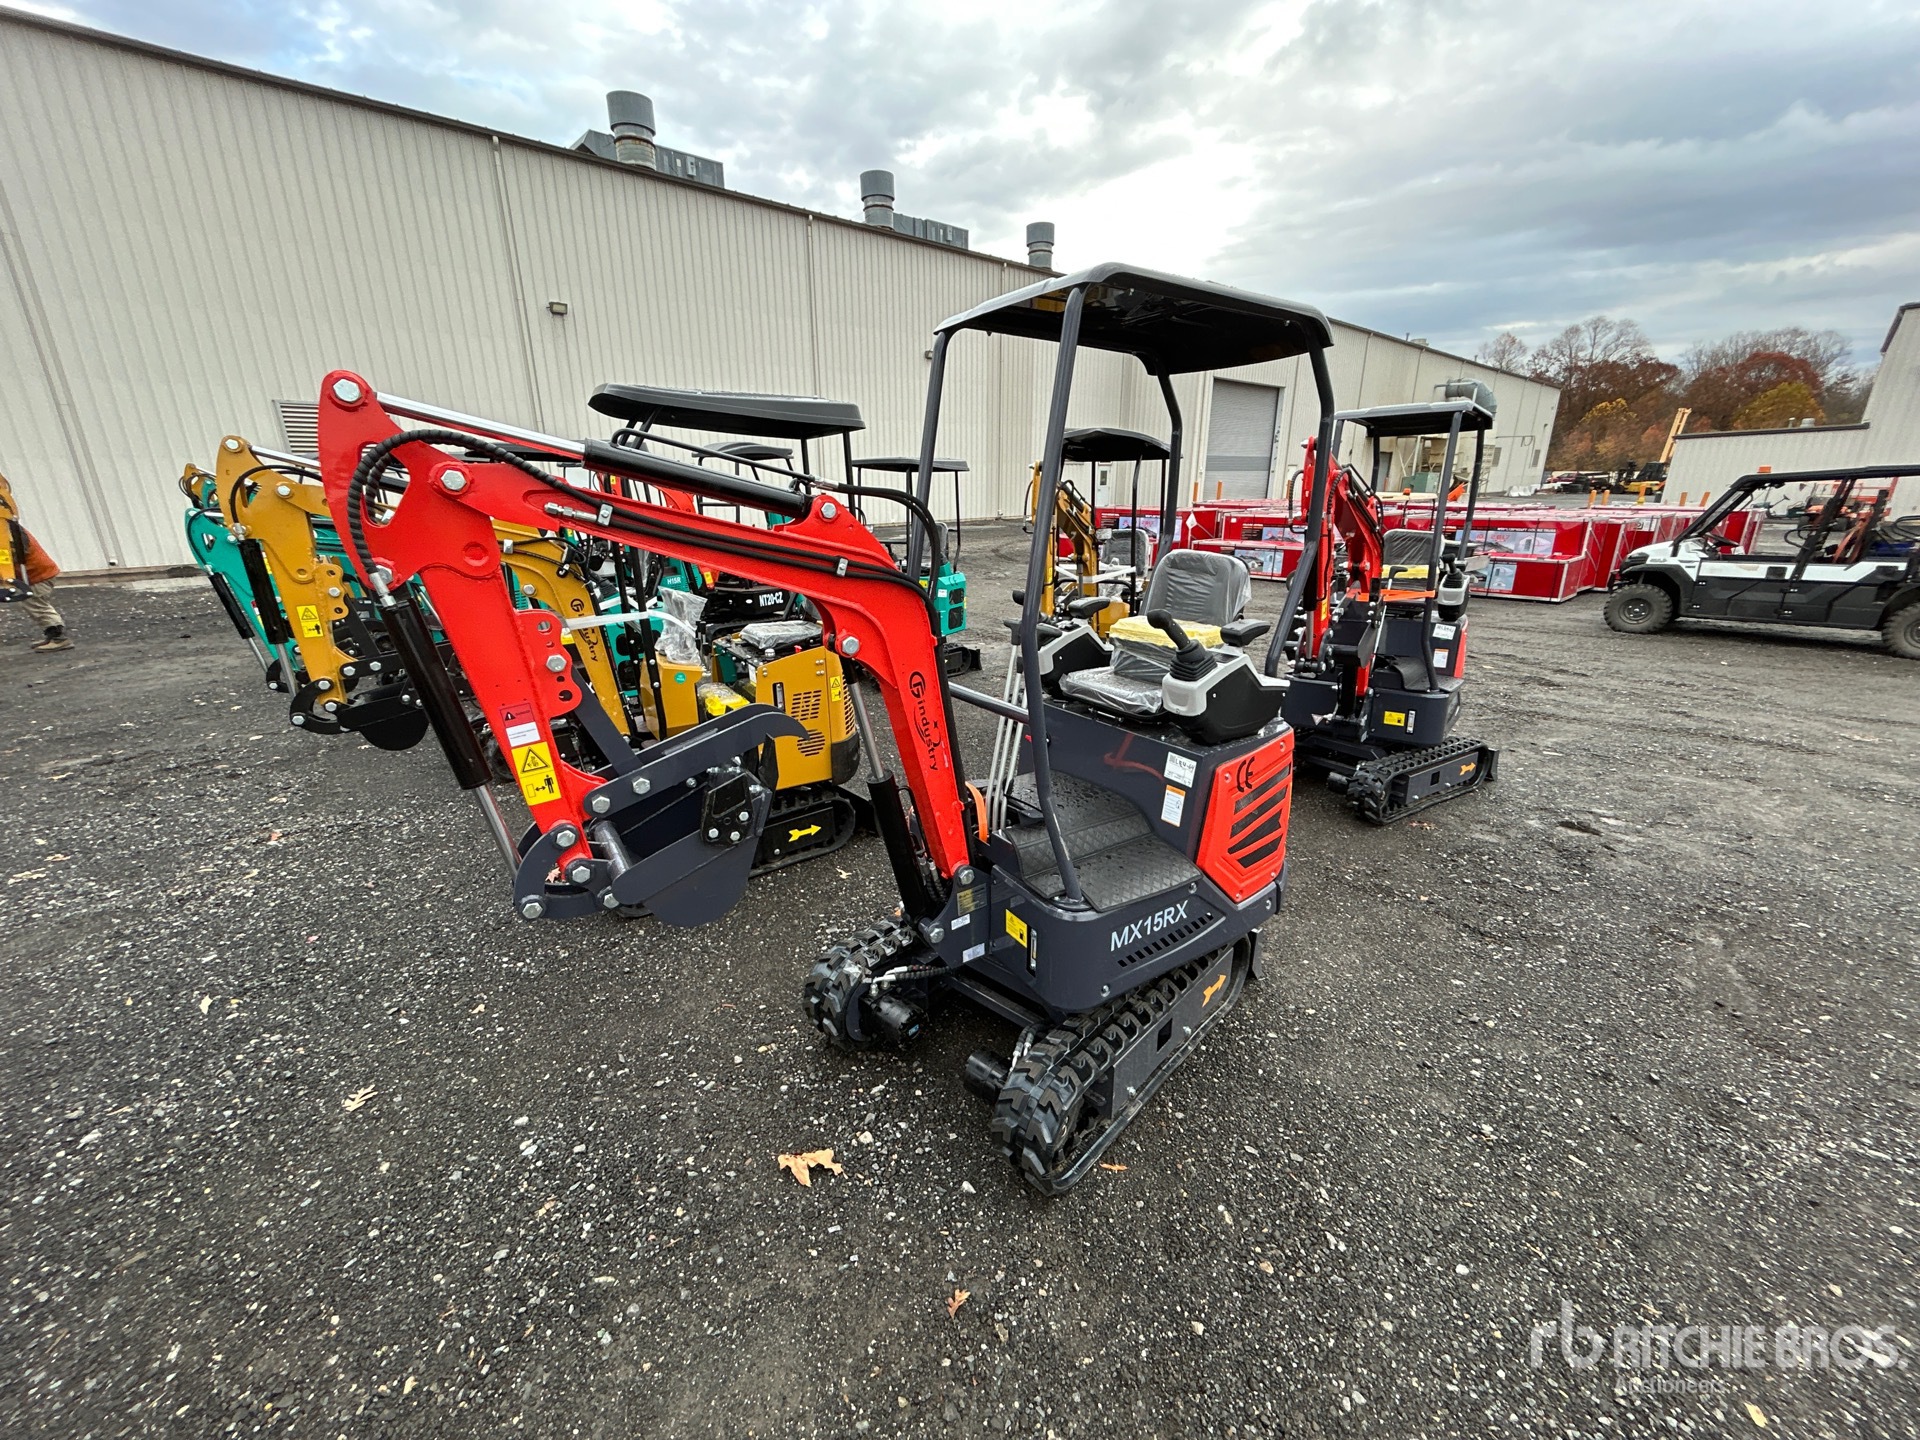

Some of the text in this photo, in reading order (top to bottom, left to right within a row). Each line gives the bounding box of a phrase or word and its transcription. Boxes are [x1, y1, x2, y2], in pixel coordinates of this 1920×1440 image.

[759, 591, 784, 607] NT20-CZ
[1236, 756, 1255, 792] CE
[1110, 900, 1189, 952] MX15RX
